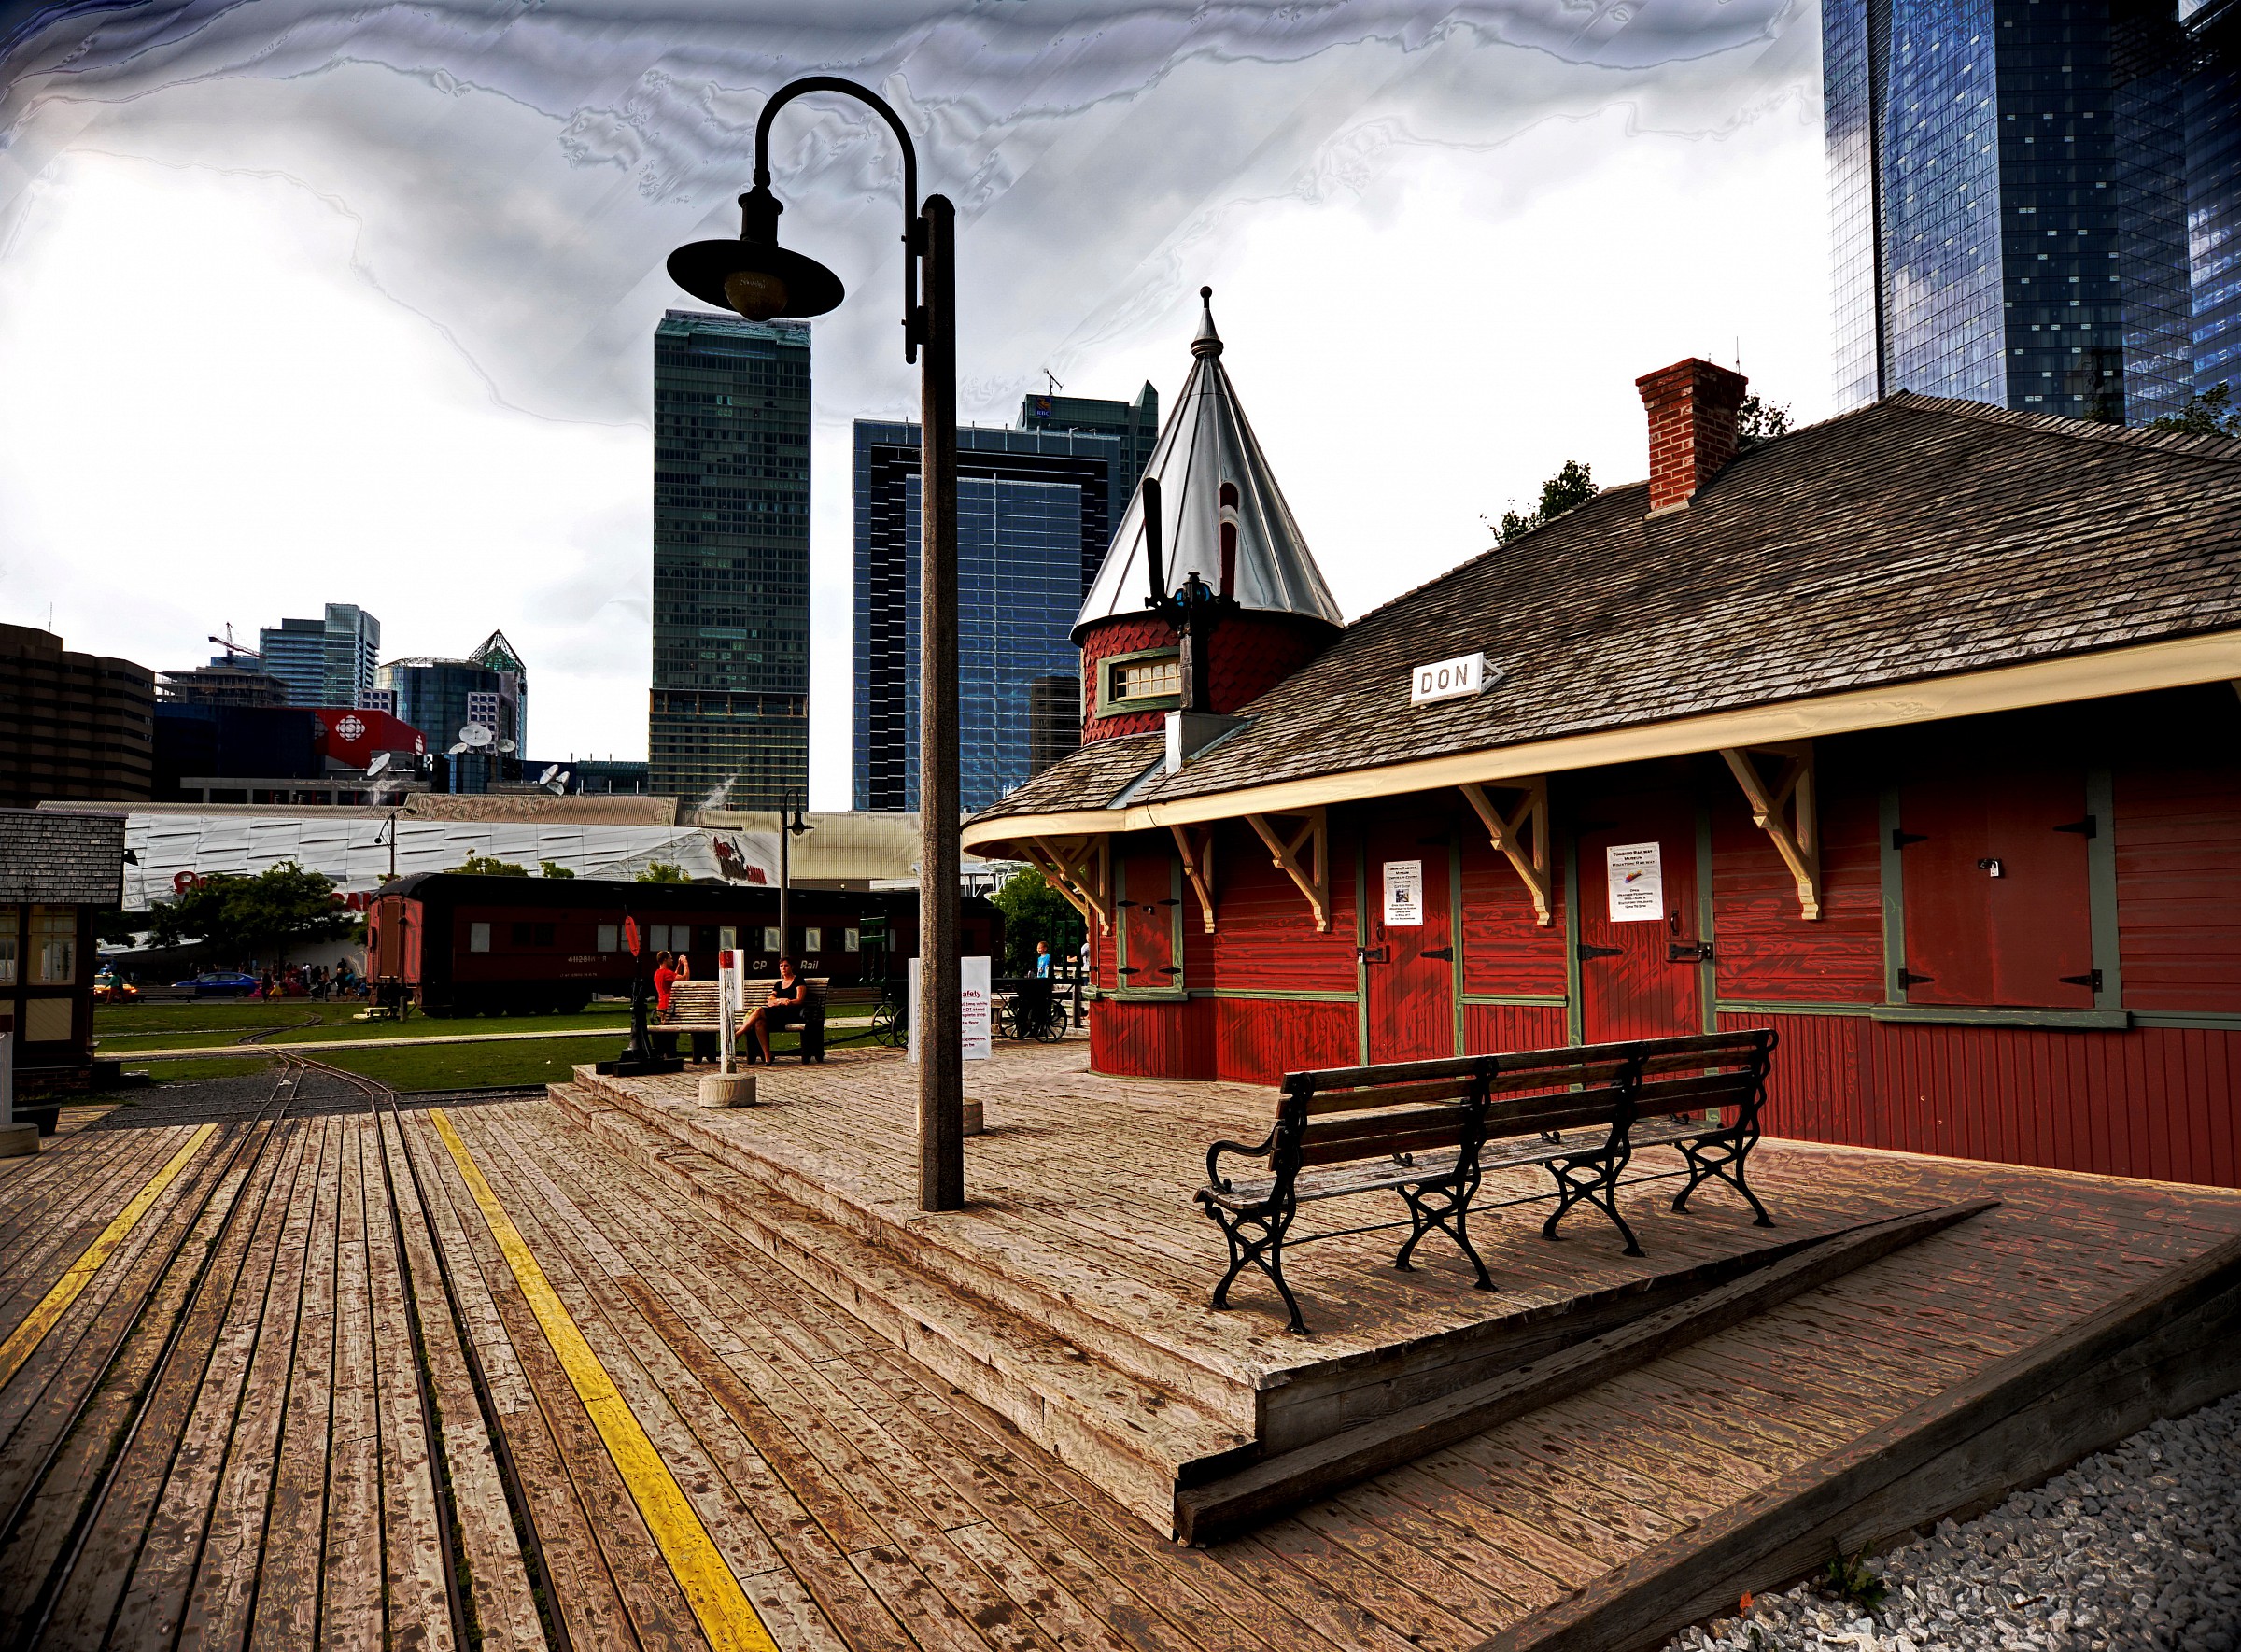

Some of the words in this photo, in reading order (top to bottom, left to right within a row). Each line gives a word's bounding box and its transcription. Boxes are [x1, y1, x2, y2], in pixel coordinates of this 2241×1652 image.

[1421, 663, 1468, 694] DON
[752, 960, 768, 970] CP
[800, 959, 819, 970] Rail
[962, 990, 981, 998] afety
